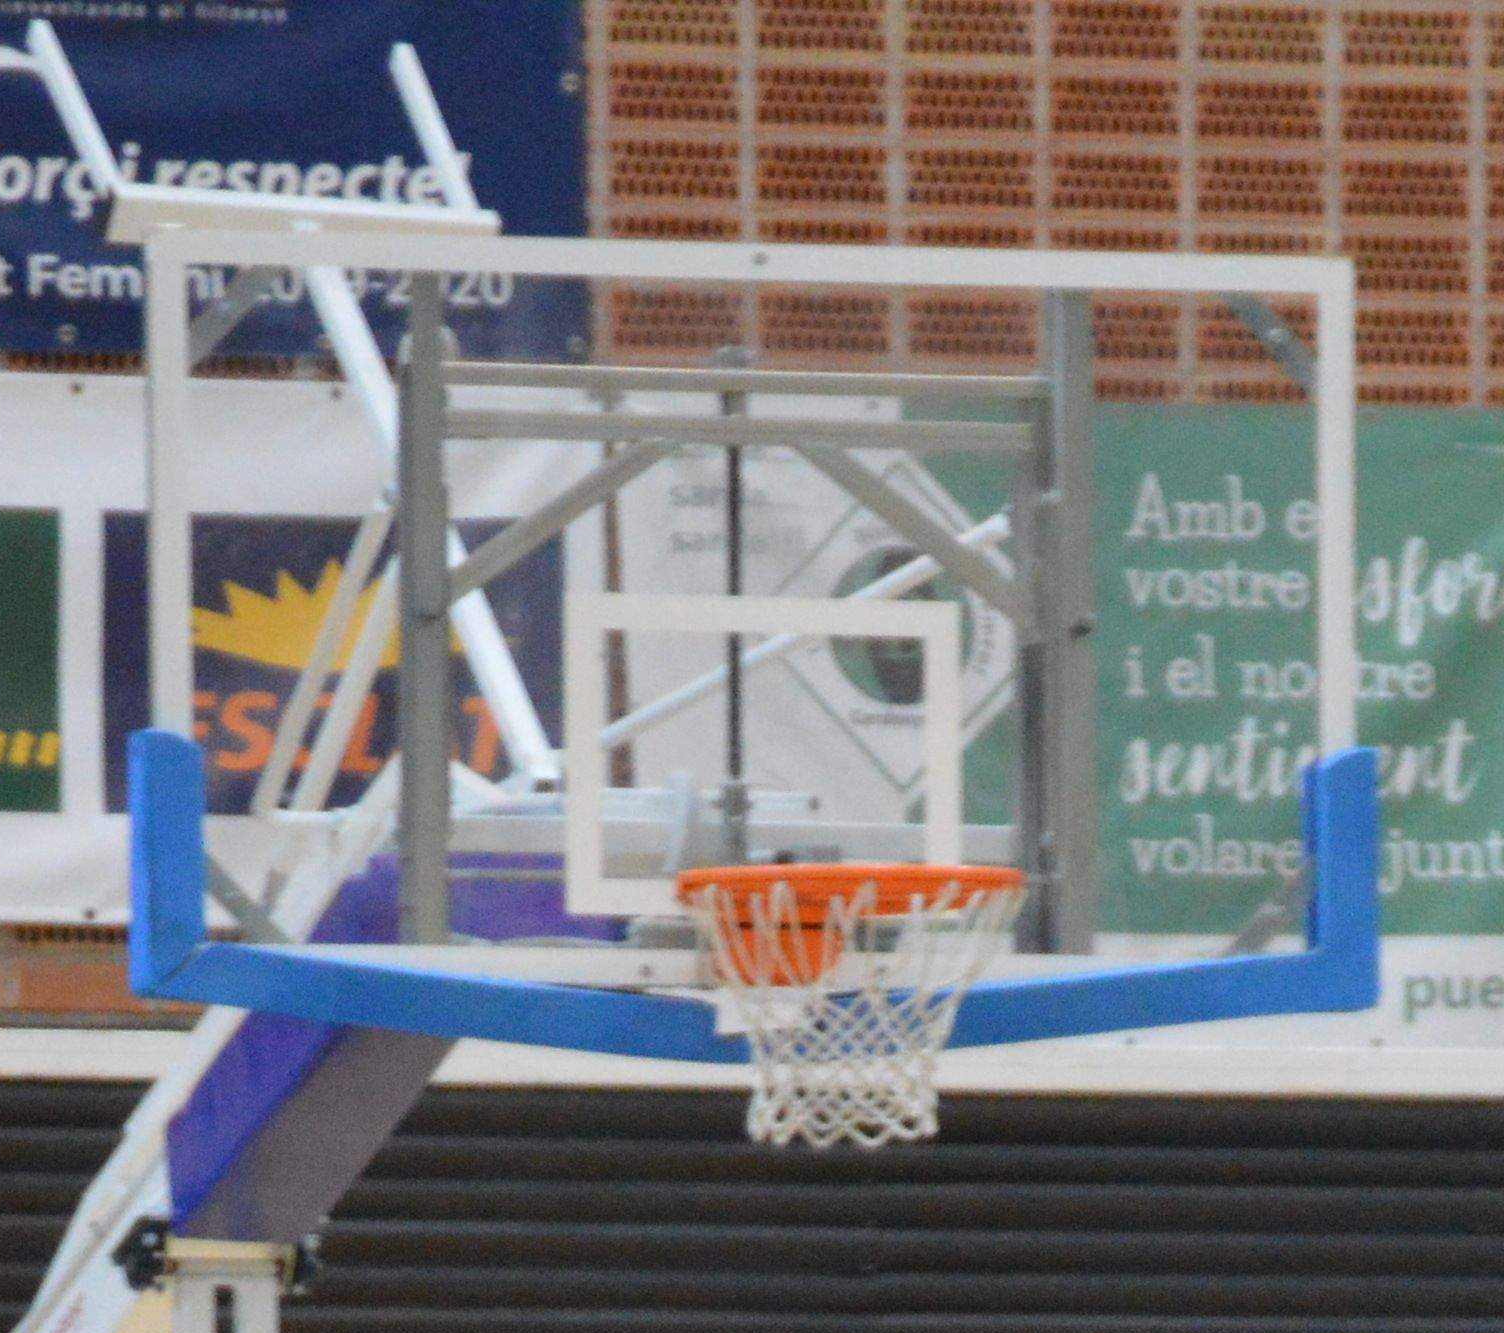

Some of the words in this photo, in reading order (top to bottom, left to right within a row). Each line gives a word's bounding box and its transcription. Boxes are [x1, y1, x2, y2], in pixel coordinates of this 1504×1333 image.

[1125, 472, 1265, 541] Amb
[1125, 560, 1311, 612] vostre
[1125, 645, 1149, 698] i
[1165, 634, 1217, 699] el
[1240, 658, 1436, 700] notre
